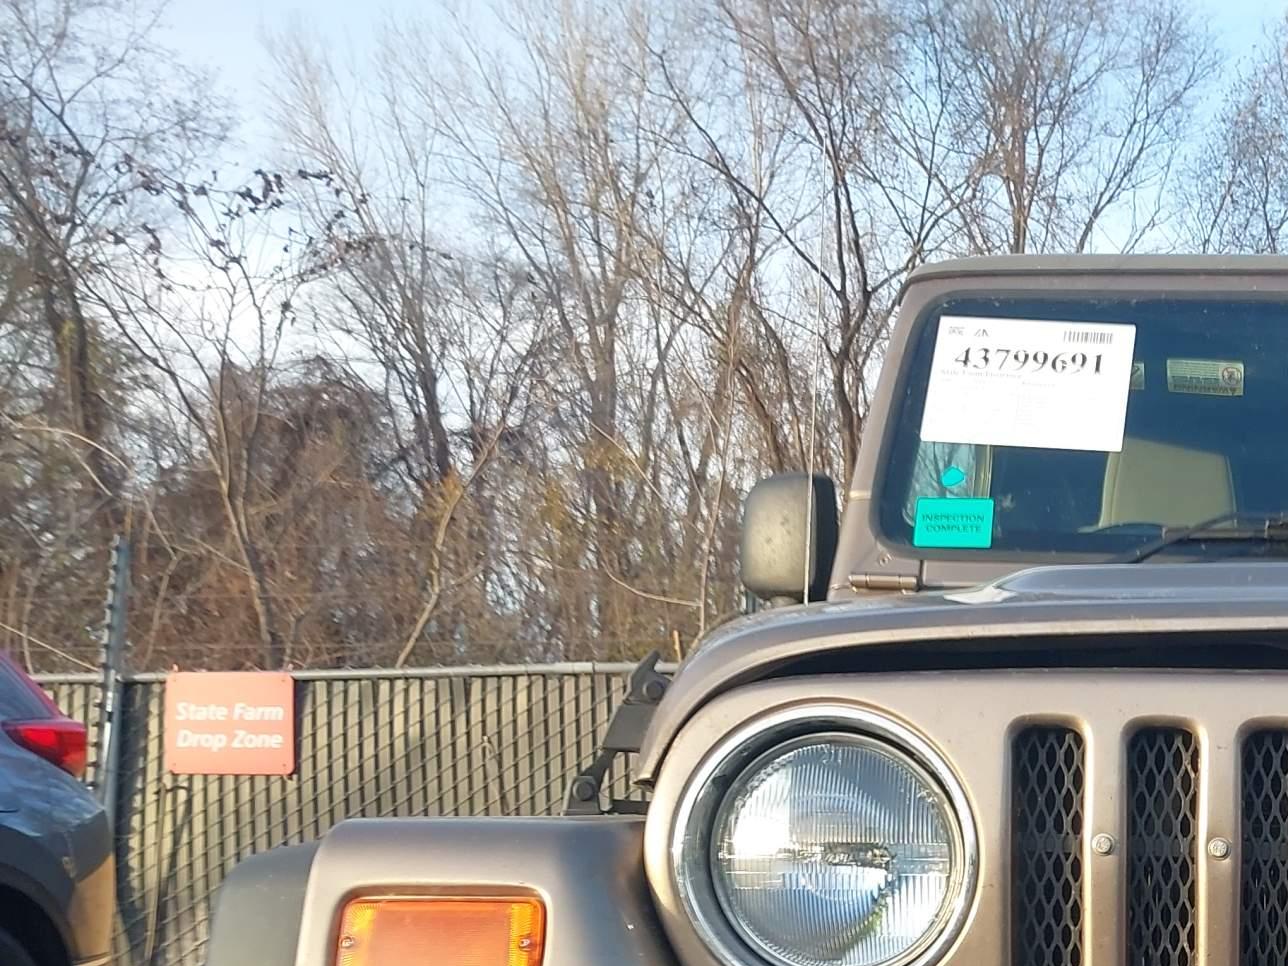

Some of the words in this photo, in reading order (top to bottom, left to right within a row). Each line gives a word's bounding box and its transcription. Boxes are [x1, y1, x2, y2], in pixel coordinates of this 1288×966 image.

[953, 346, 1103, 375] 43799691
[921, 512, 985, 523] INSPECTION
[925, 523, 982, 534] COMPLETE
[176, 702, 228, 721] State
[232, 702, 285, 721] Farm
[176, 729, 228, 753] Drop
[231, 730, 285, 749] Zone
